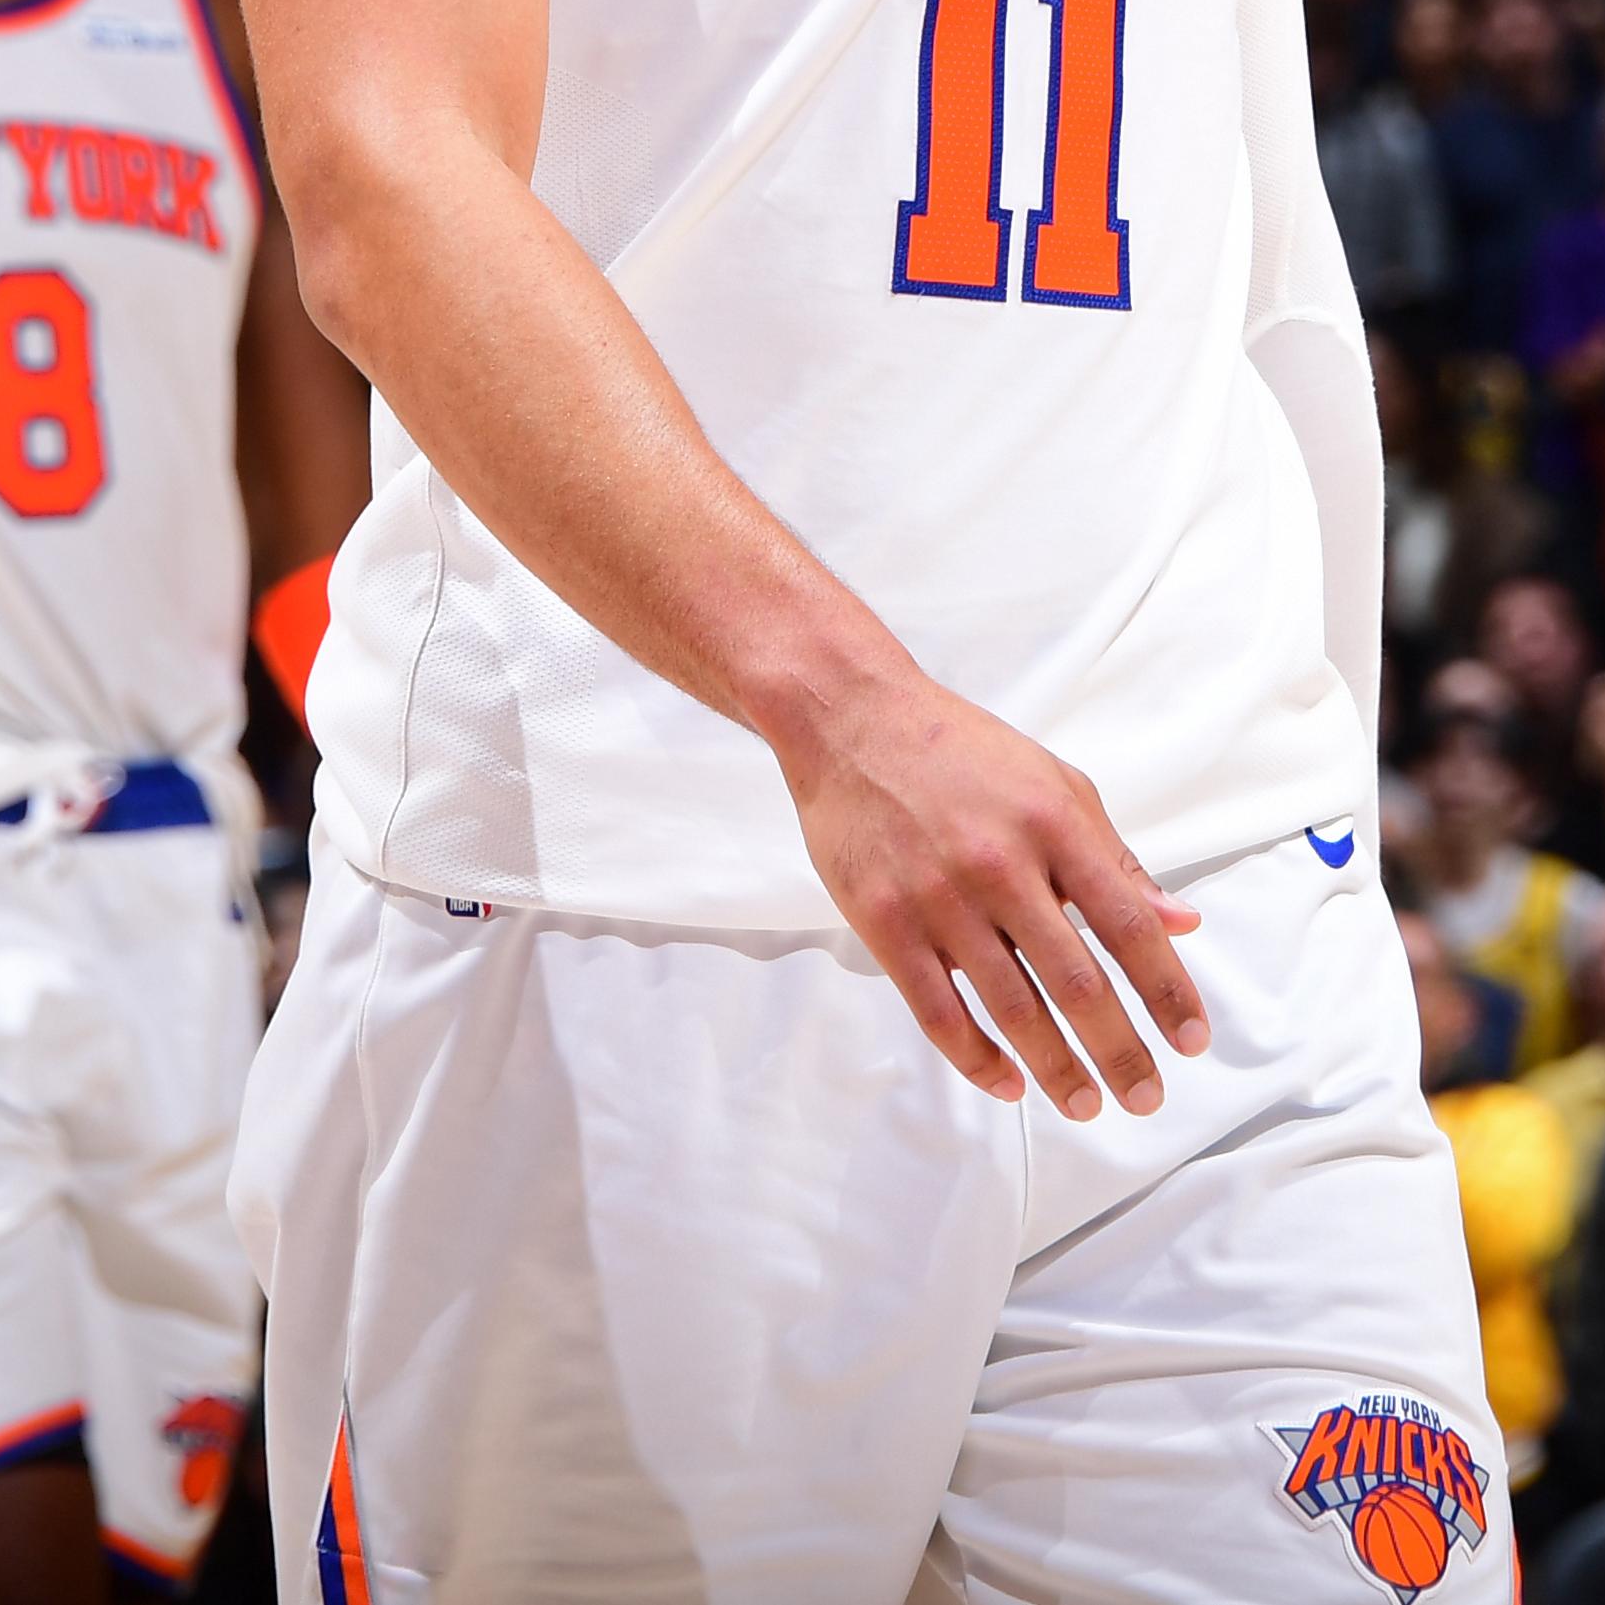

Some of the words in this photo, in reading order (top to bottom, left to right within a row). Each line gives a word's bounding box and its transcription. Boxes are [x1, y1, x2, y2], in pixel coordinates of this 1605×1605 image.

[1, 120, 230, 256] YORK
[450, 898, 474, 912] NBA
[1357, 1395, 1396, 1415] NEW
[1400, 1397, 1443, 1432] YORK
[1284, 1404, 1487, 1536] KNICKS
